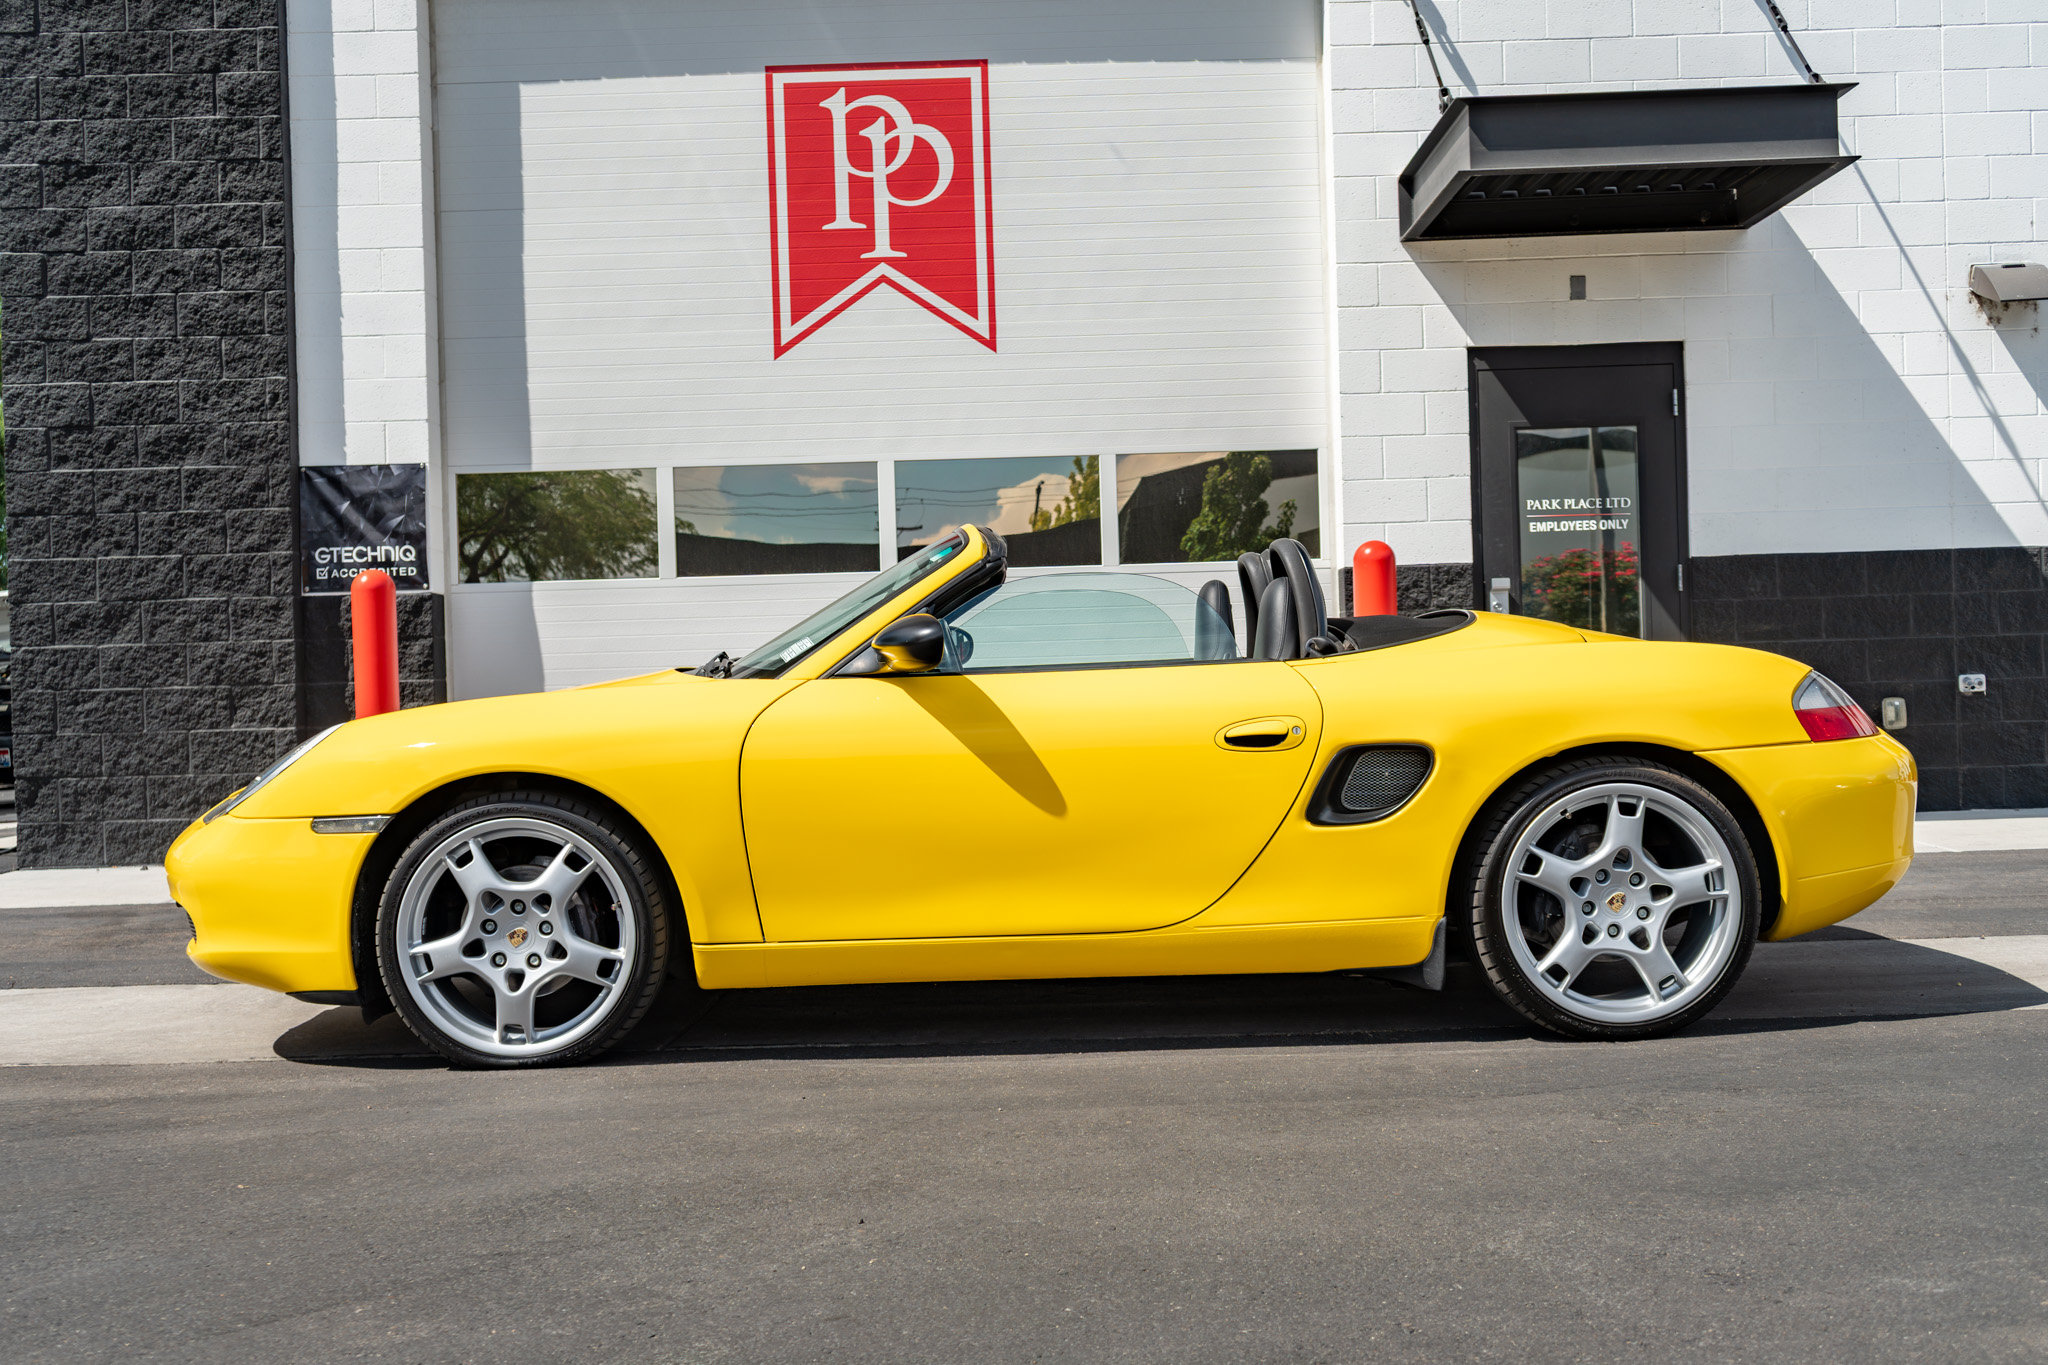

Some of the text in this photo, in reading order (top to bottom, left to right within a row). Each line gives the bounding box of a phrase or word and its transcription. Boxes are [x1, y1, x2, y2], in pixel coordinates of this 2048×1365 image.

[1526, 497, 1631, 510] PARK PLACE LTD
[1529, 519, 1629, 532] EMPLOYEES ONLY
[315, 545, 416, 564] GTECHNIQ
[331, 567, 417, 578] ACCITED
